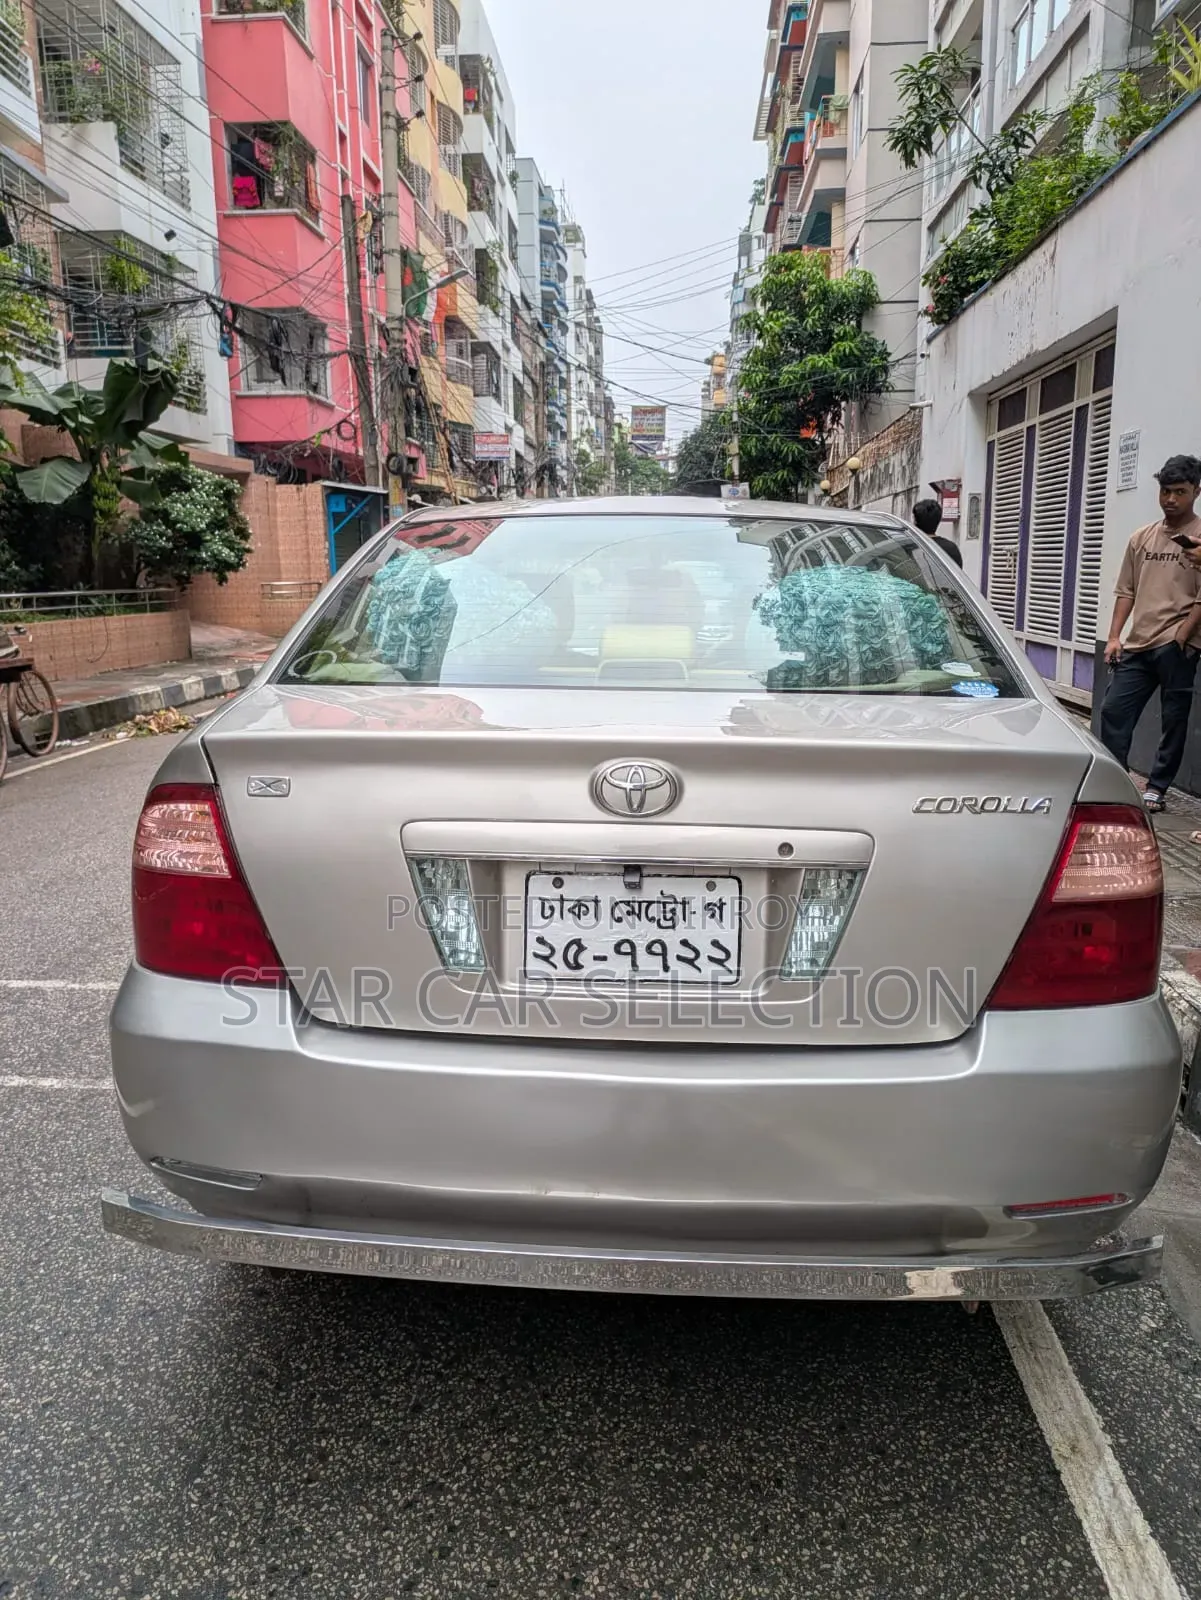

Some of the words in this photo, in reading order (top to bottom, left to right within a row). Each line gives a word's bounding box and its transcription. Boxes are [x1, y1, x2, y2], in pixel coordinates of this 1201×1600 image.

[1144, 551, 1181, 562] EARTH
[911, 795, 1054, 816] COROLLA
[538, 893, 601, 922] ঢাকা
[532, 935, 734, 975] ২৫-৭৭২২
